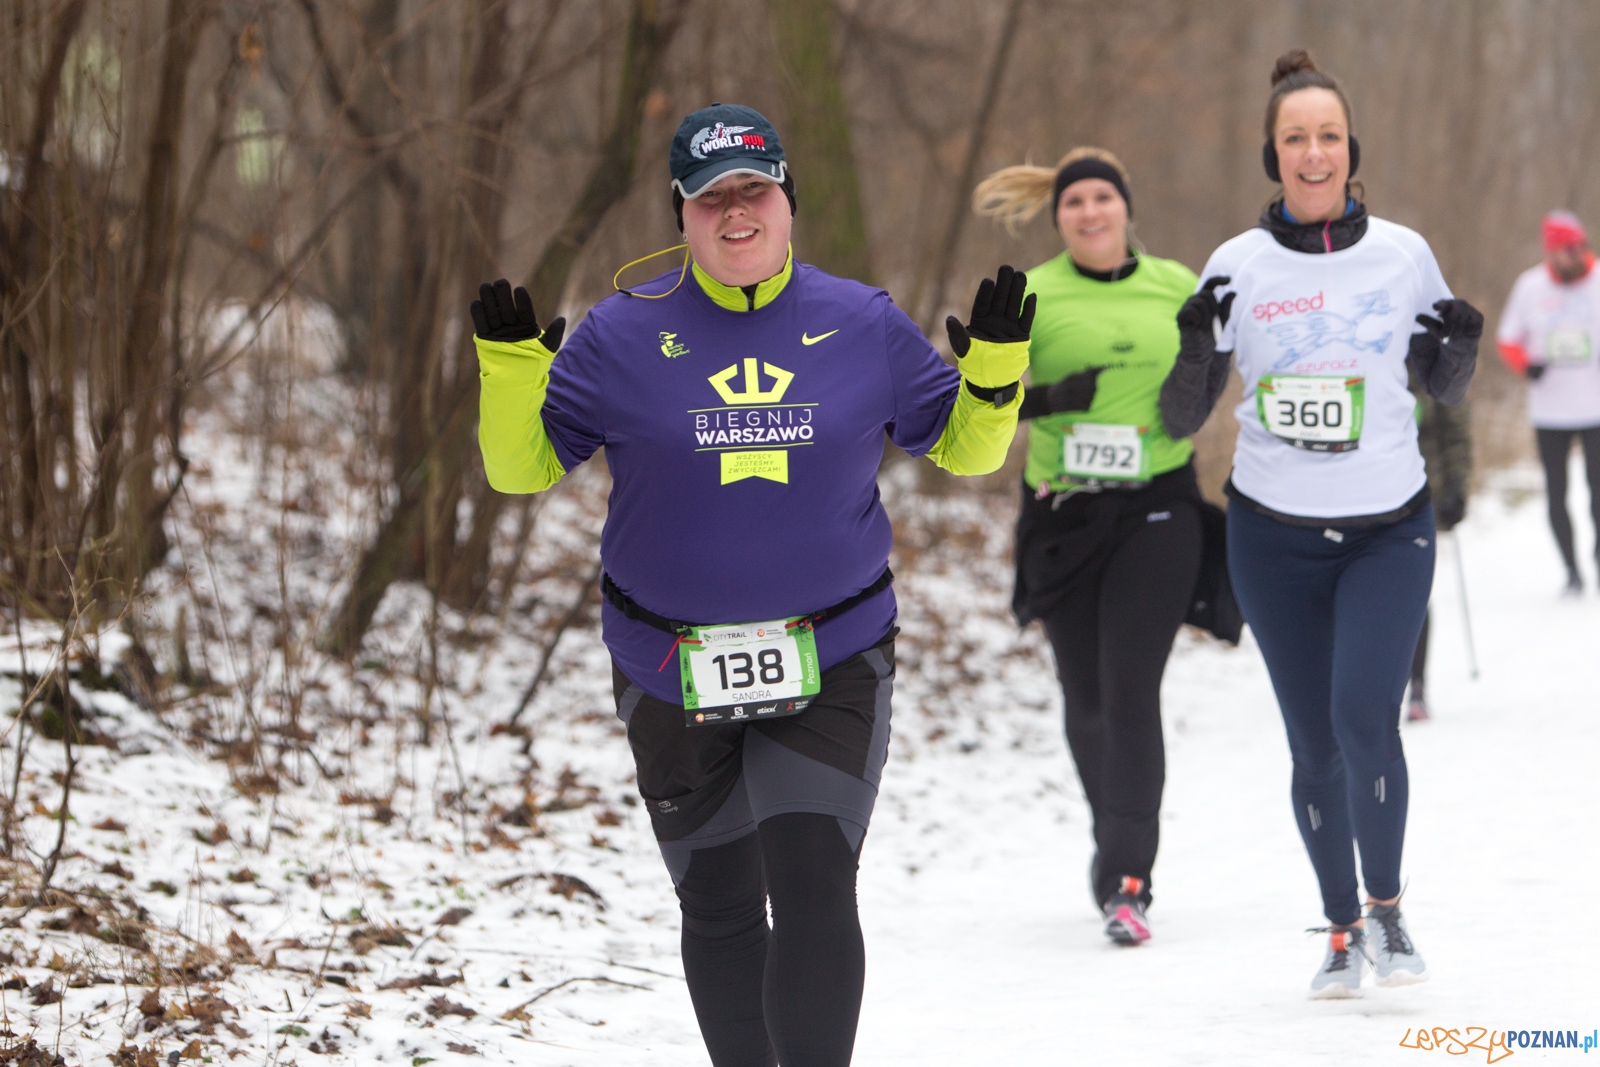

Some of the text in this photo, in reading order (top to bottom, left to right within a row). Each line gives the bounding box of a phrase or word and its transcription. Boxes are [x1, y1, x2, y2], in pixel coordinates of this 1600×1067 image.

[1253, 290, 1323, 322] speed
[1296, 359, 1358, 373] szuracz
[696, 408, 812, 429] BIEGNIJ
[1278, 400, 1342, 427] 360
[695, 424, 814, 445] WARSZAWO
[1074, 442, 1135, 469] 1792
[712, 648, 785, 690] 138
[804, 652, 816, 684] Poznań
[732, 690, 772, 702] SANDRA
